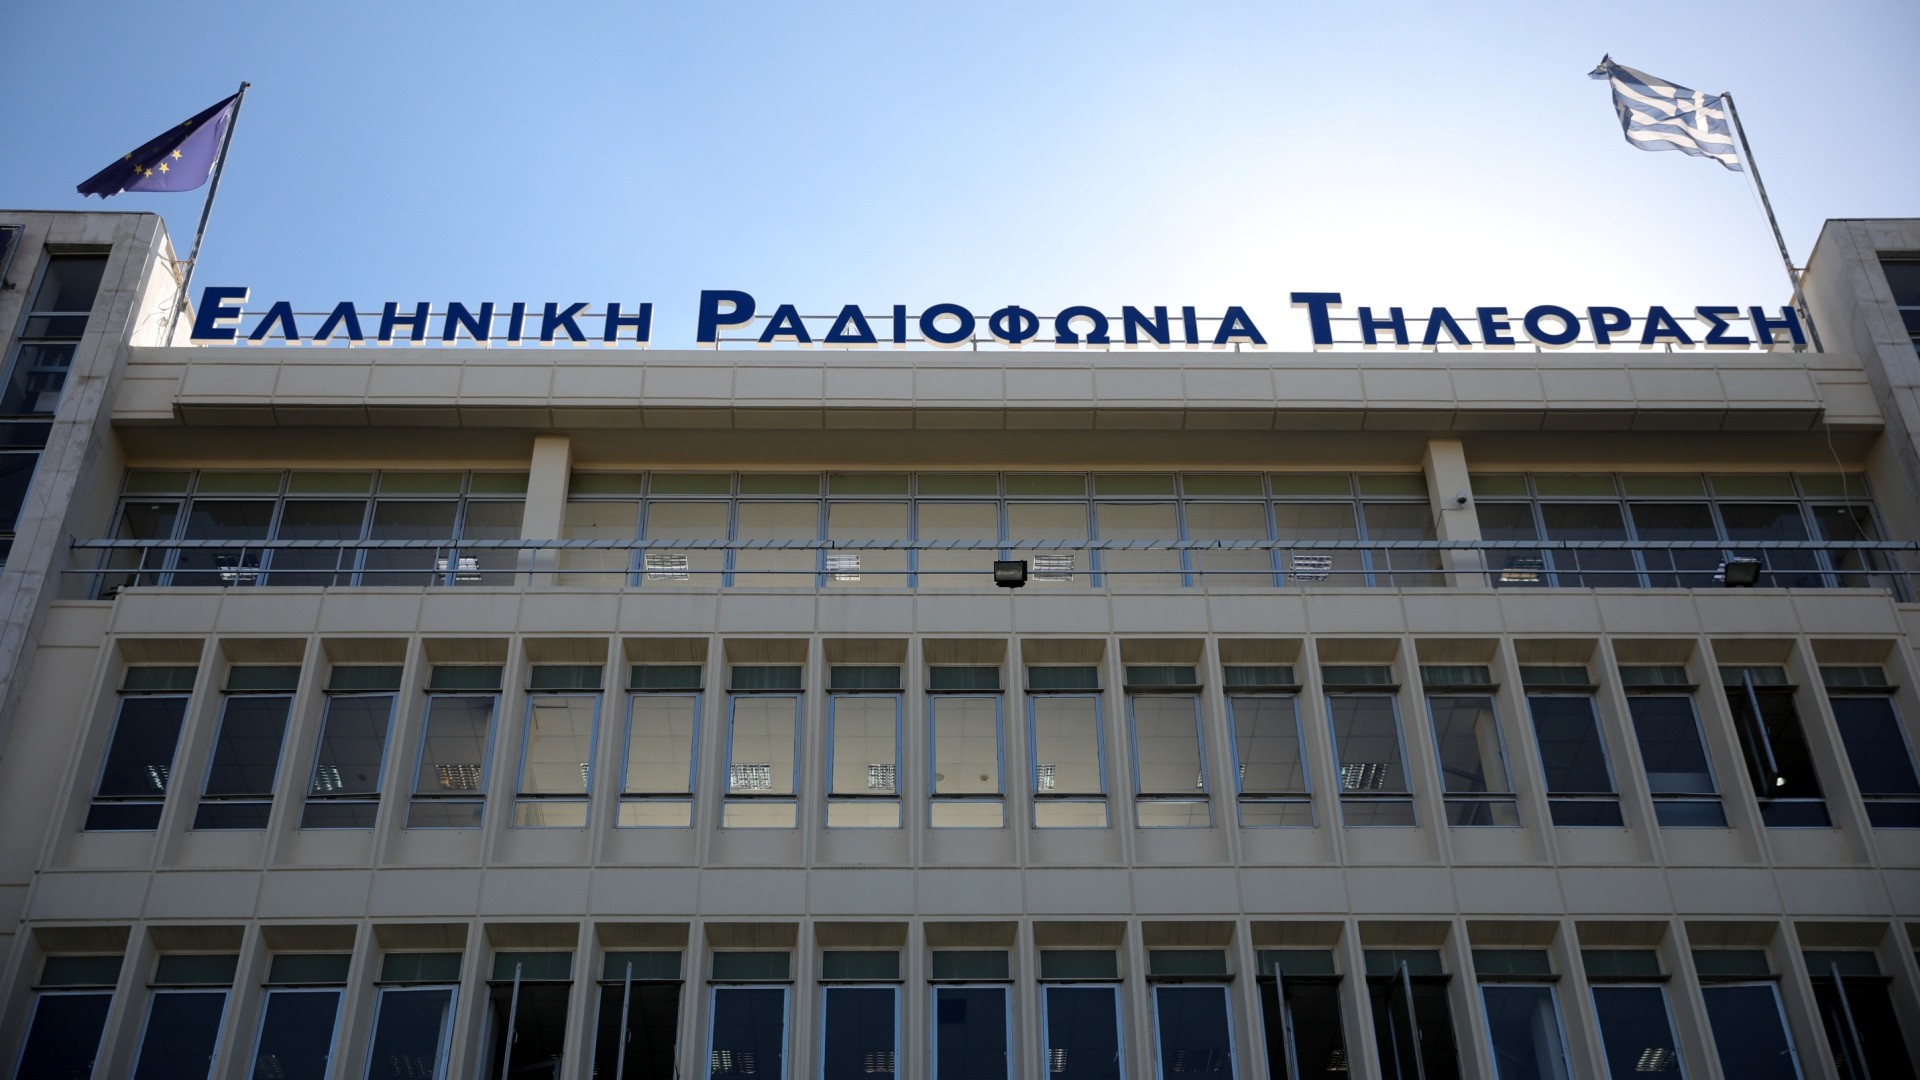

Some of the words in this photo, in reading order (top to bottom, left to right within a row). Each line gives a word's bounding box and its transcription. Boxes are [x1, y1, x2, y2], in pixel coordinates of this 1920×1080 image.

[191, 286, 654, 345] ΕΛΛΗΝΙΚΗ
[696, 289, 1268, 349] ΡΑΔΙΟΦΩΝΙΑ
[1290, 292, 1807, 350] ΤΗΛΕΟΡΑΣΗ
